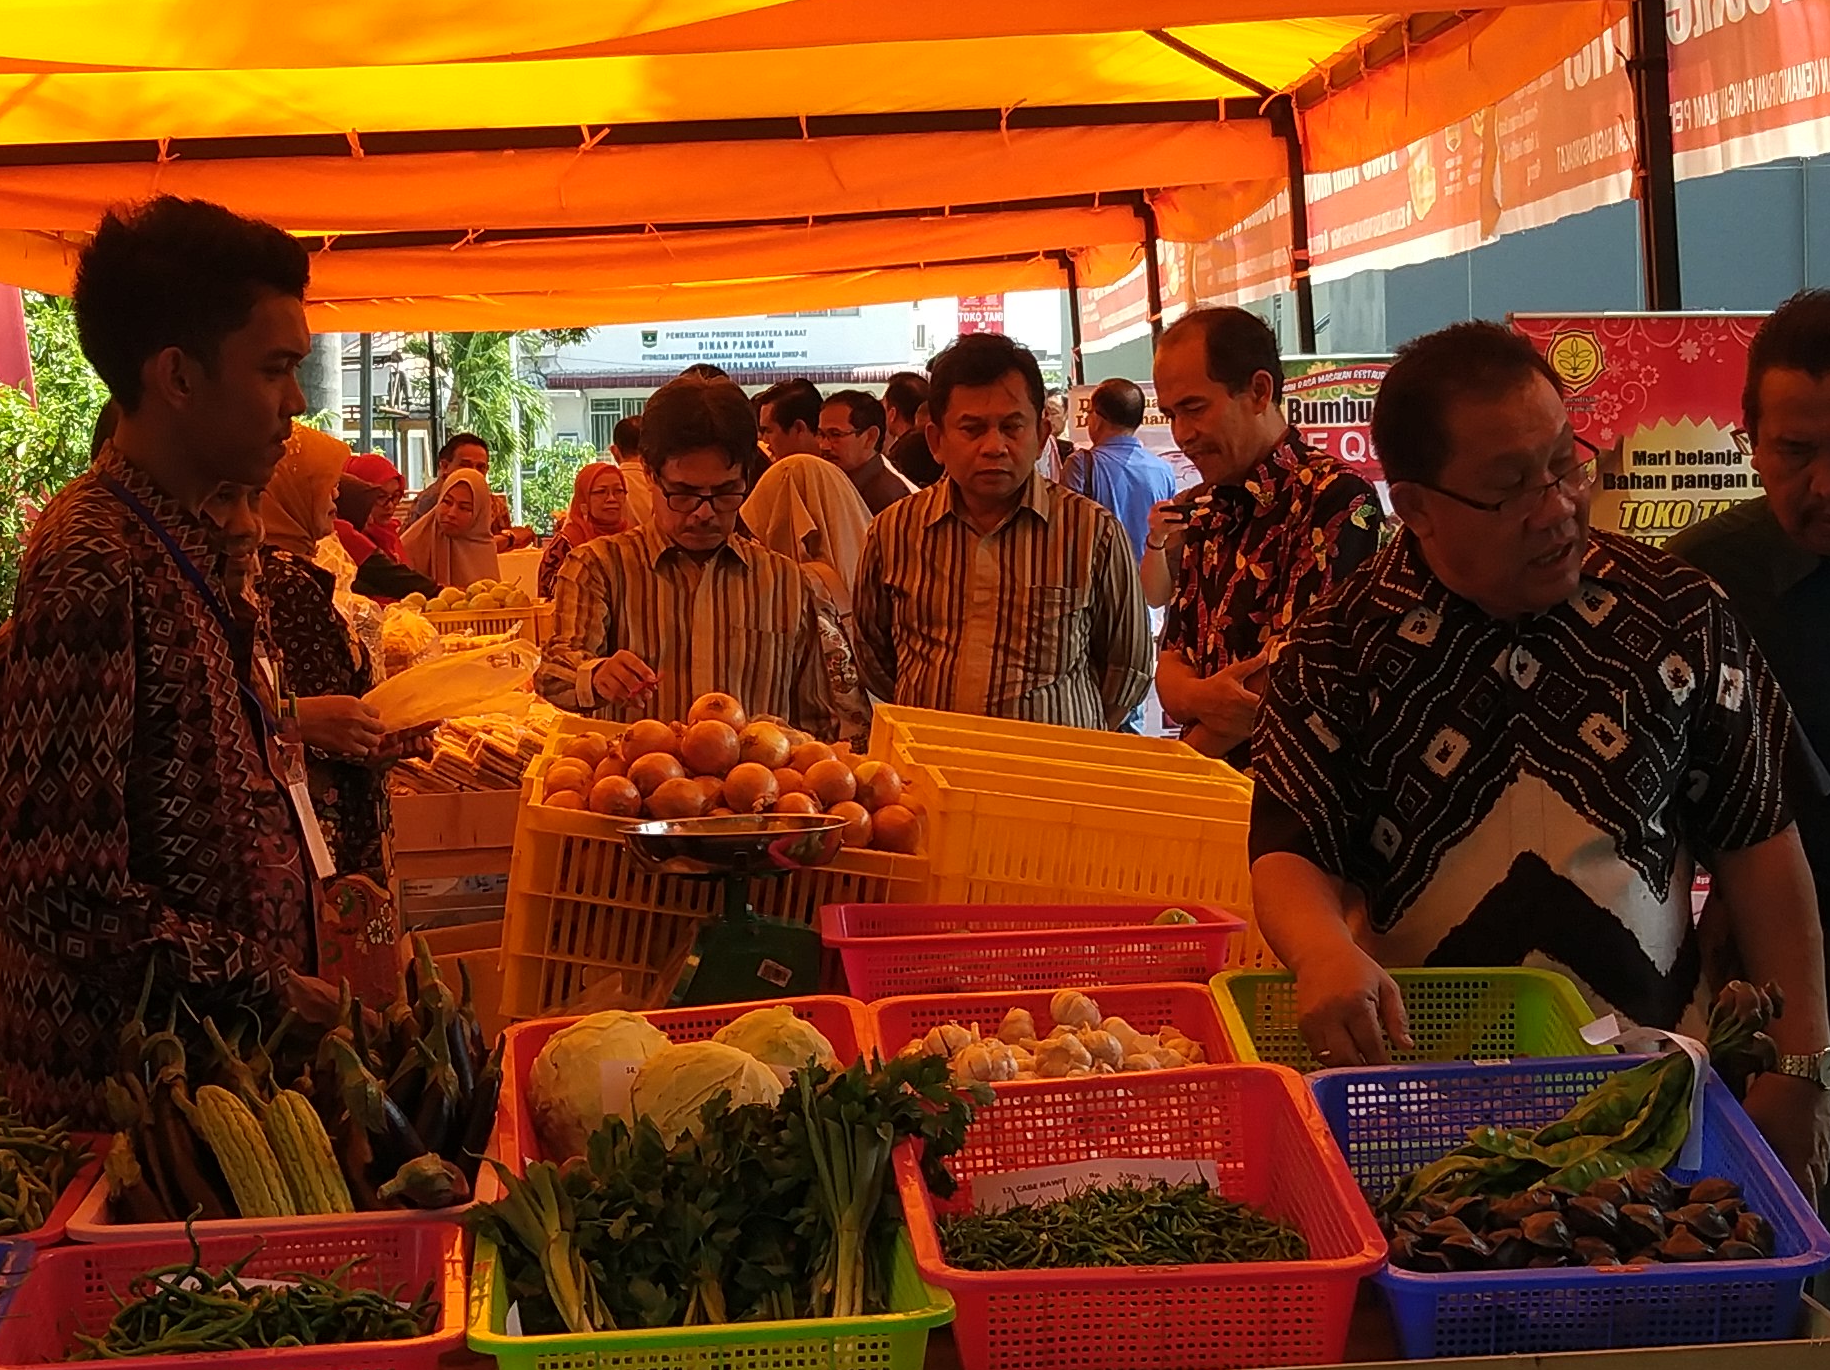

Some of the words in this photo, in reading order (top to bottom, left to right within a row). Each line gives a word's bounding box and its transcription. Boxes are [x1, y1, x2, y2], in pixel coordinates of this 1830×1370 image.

[698, 340, 729, 351] DINAS
[733, 340, 775, 350] PANGAN
[1353, 369, 1387, 381] RESTAUR
[1286, 396, 1374, 425] Bumbu
[1631, 449, 1671, 467] Mari
[1674, 449, 1743, 468] belanja
[1602, 472, 1667, 490] Bahan
[1670, 472, 1748, 491] pangan
[1618, 498, 1696, 531] TOKO
